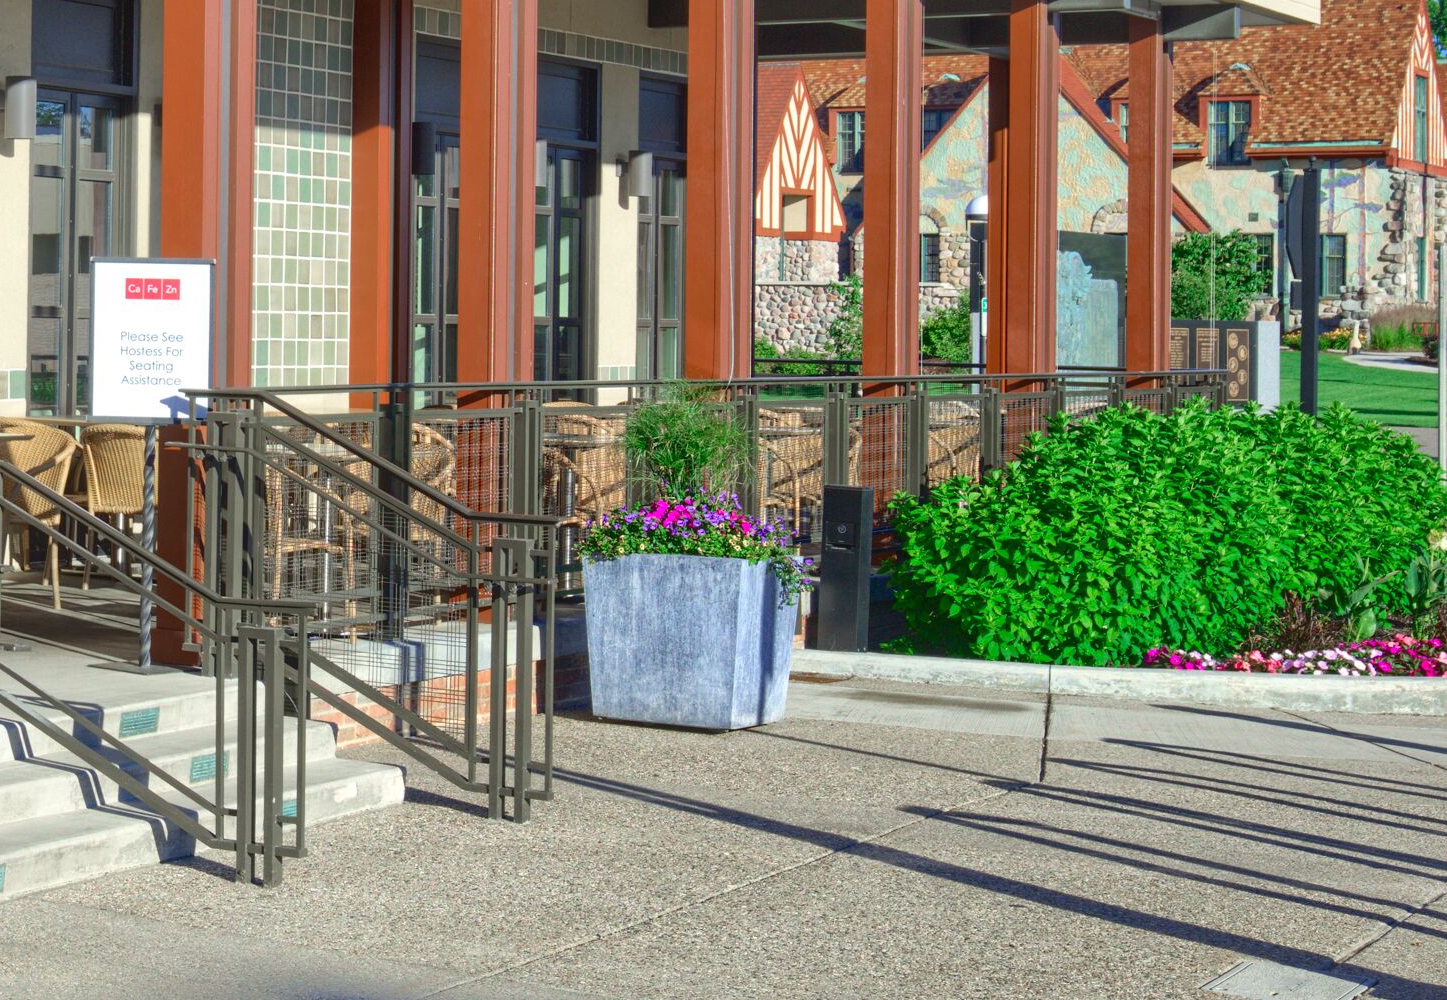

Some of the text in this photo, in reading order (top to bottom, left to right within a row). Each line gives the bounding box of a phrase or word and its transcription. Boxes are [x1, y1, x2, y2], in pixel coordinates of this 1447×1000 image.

[128, 284, 177, 294] Ca Fe Zn
[120, 331, 184, 342] Please See
[120, 346, 184, 356] Hostess For
[129, 360, 173, 373] Seating
[120, 375, 182, 385] Assistance
